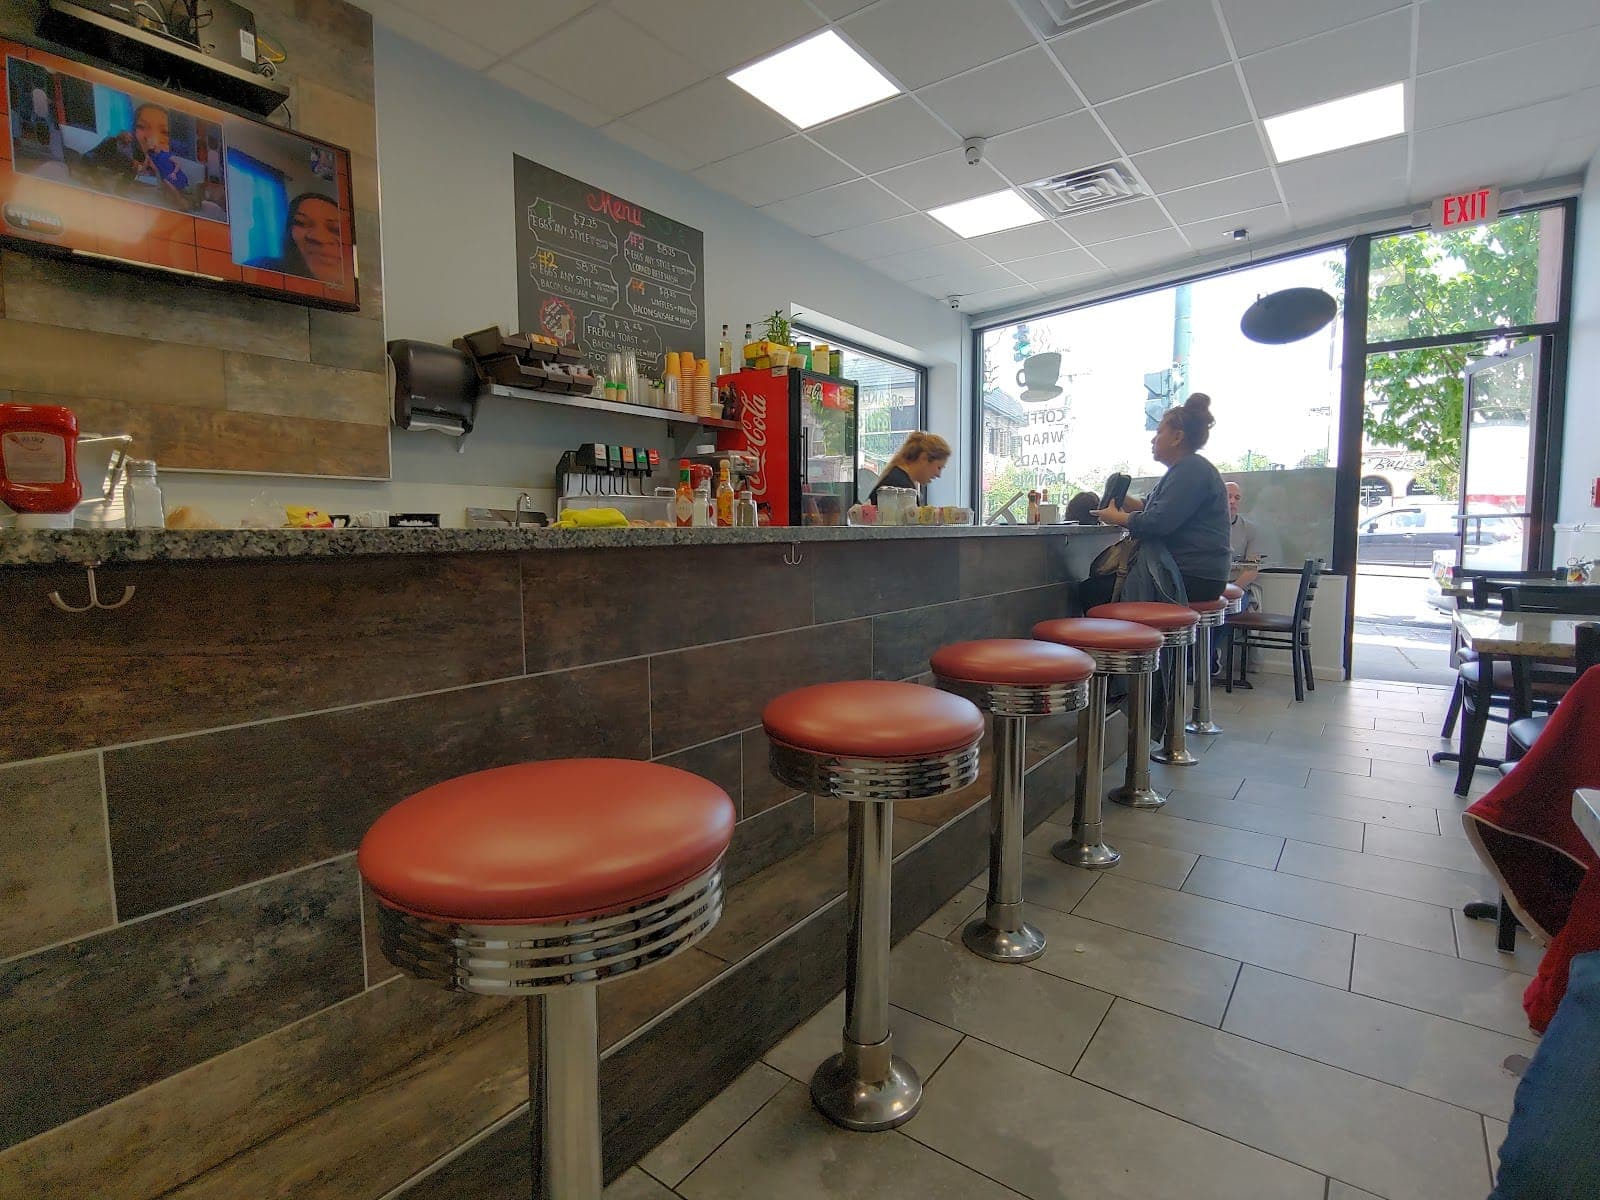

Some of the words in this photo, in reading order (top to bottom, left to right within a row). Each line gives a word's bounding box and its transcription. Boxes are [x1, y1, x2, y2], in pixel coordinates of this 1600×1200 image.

[585, 191, 646, 228] Menu
[1443, 189, 1490, 227] EXIT
[570, 228, 590, 243] STYLE
[537, 251, 558, 269] #2
[587, 325, 616, 341] FRENCH
[618, 332, 638, 344] TOAST
